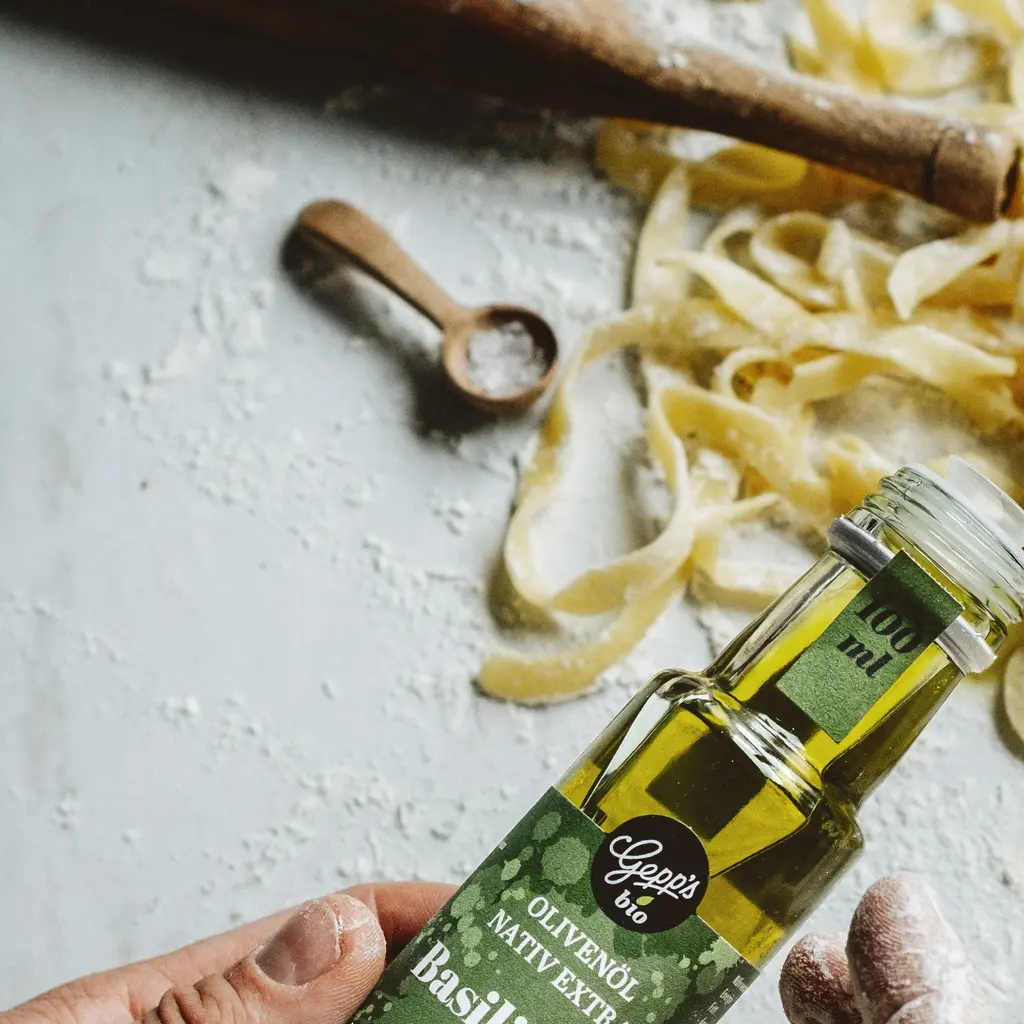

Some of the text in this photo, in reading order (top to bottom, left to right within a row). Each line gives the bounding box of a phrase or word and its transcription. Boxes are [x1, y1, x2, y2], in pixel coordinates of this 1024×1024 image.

[854, 596, 922, 654] 100
[837, 636, 893, 679] ml
[604, 835, 700, 900] Gepp's
[614, 889, 655, 925] bio
[487, 909, 561, 974] NATIV
[527, 896, 640, 1003] OLIVENÖL
